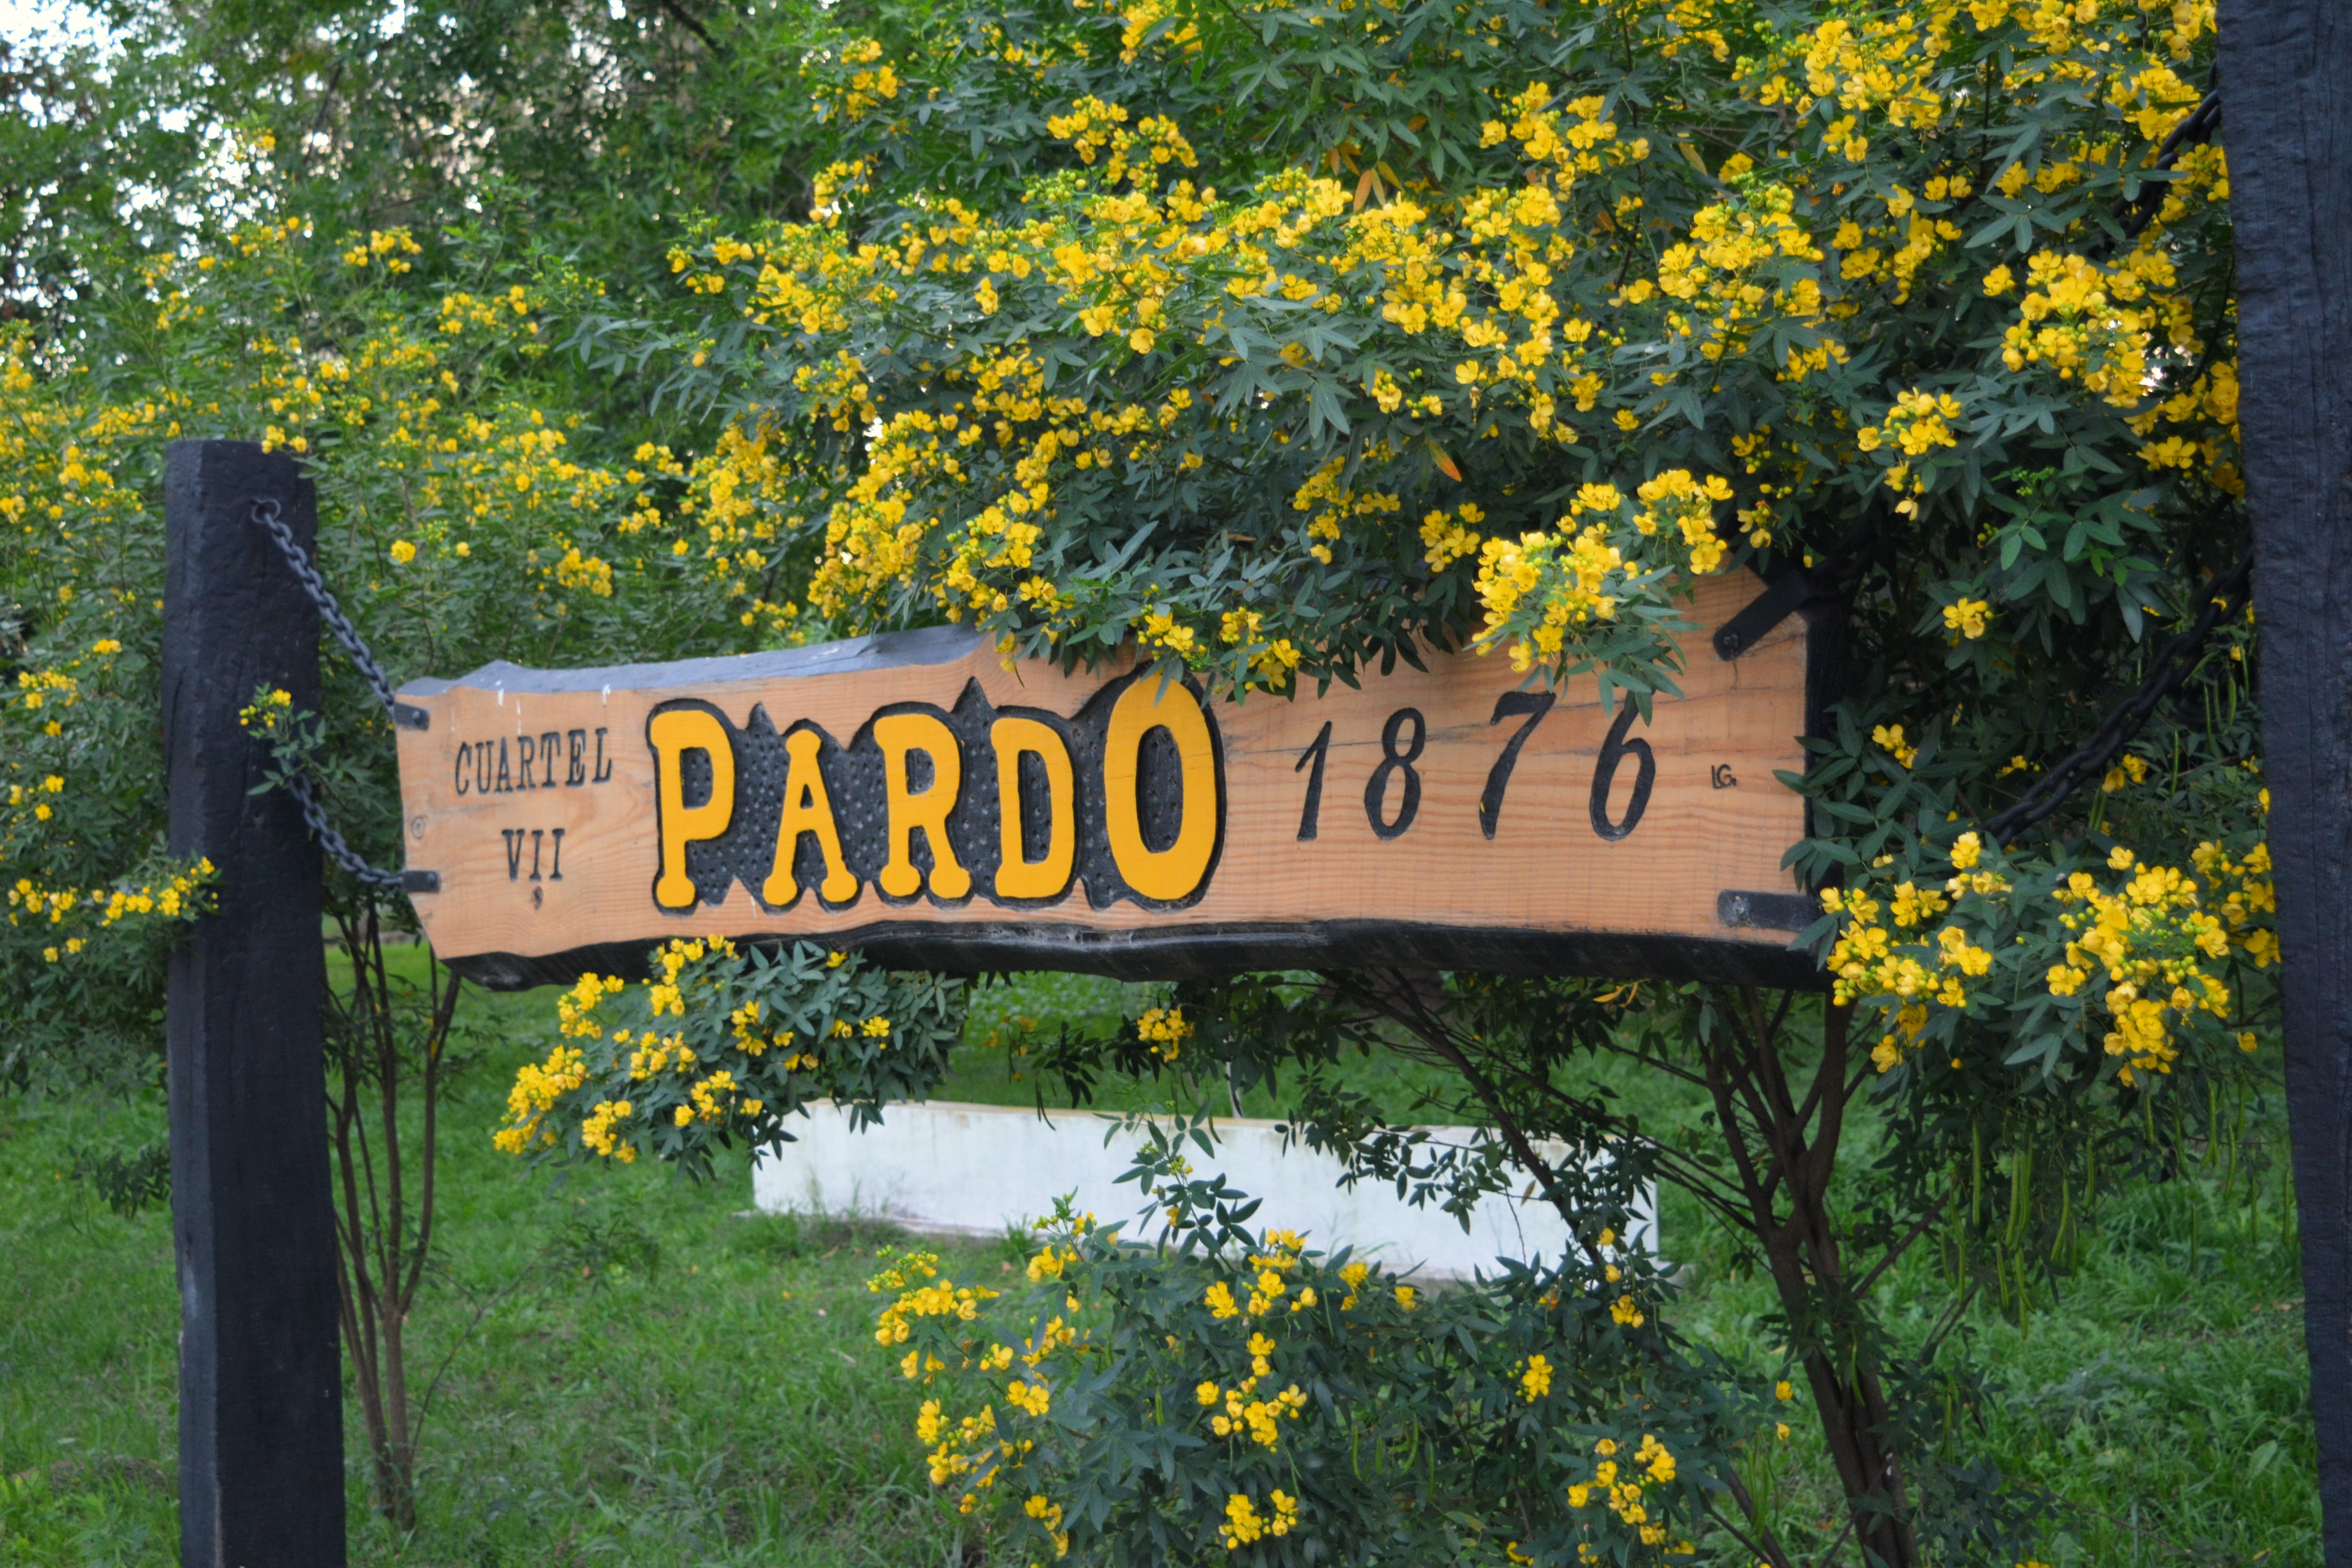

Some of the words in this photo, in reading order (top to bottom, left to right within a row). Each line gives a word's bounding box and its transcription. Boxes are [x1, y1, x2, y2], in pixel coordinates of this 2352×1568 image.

[454, 728, 612, 796] CUARTEL
[650, 674, 1217, 908] PARDO
[1294, 687, 1656, 842] 1876
[501, 828, 565, 882] VII
